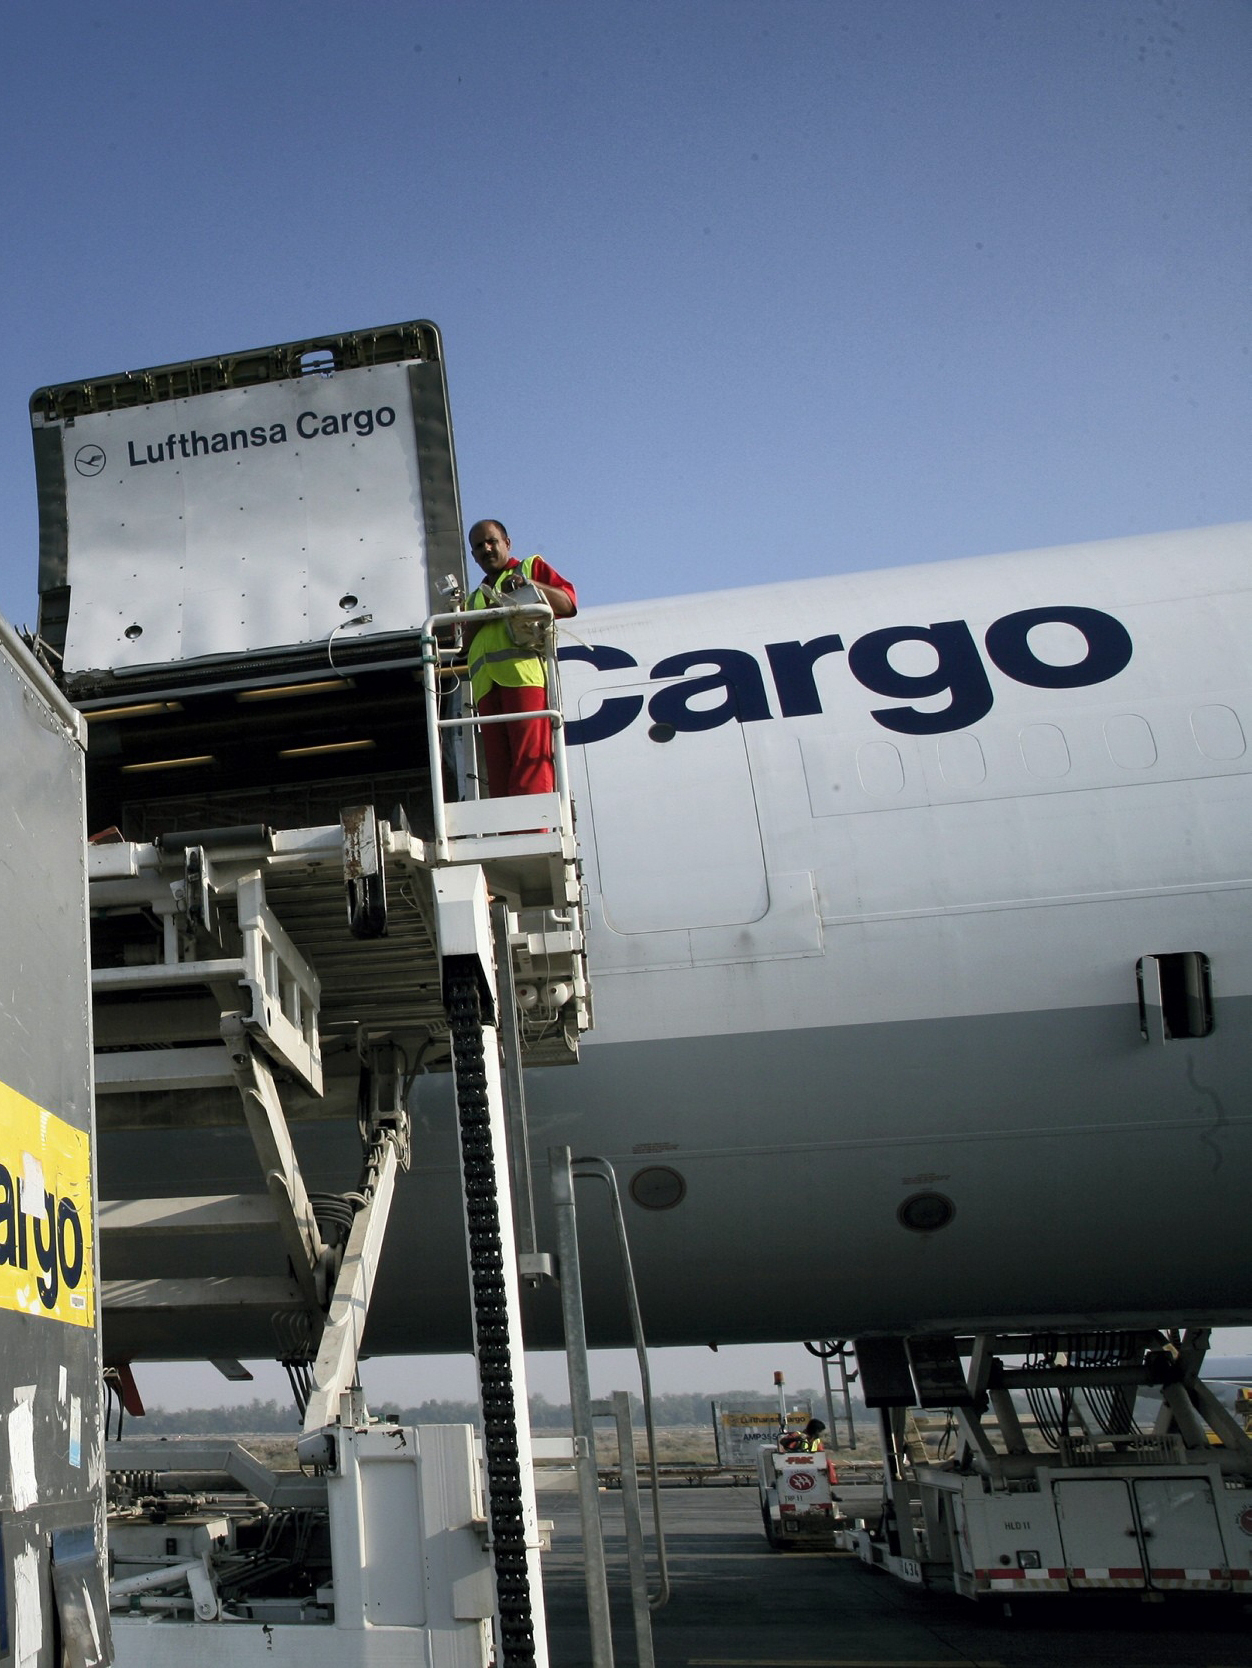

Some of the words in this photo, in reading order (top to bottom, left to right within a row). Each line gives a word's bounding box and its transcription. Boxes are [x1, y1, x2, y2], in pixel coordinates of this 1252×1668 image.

[127, 422, 288, 467] Lufthansa
[295, 405, 397, 439] Cargo
[1004, 1521, 1021, 1530] HLD
[1023, 1521, 1031, 1530] 11
